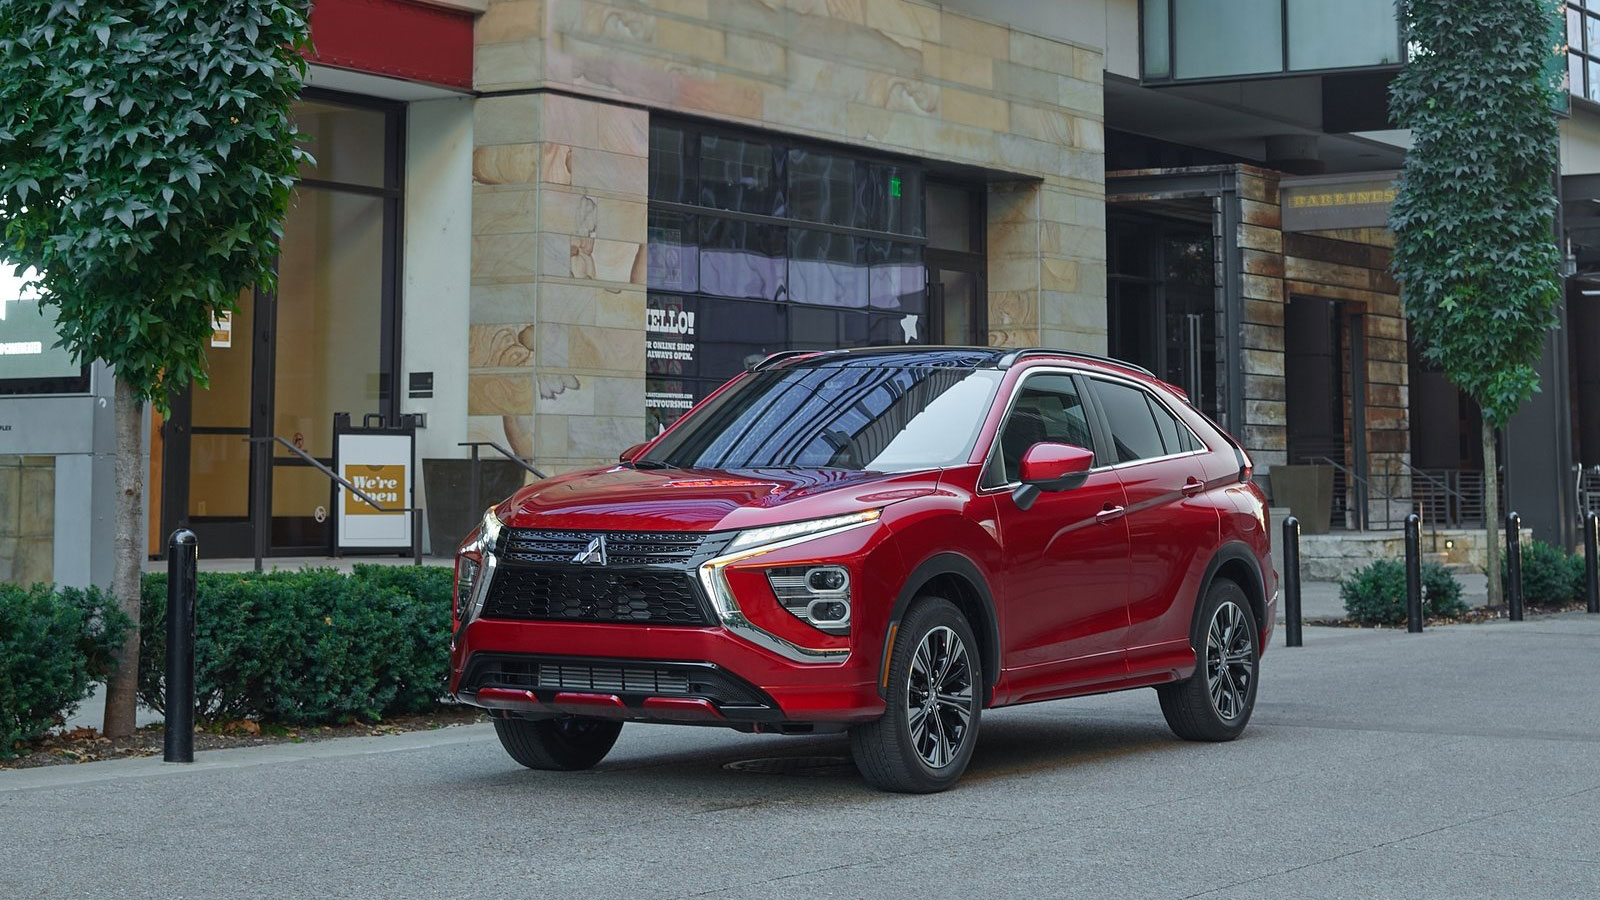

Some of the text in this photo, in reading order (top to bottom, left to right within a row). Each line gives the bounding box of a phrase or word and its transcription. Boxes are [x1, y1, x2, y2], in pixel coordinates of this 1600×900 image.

[652, 341, 676, 350] ONLINE
[677, 342, 695, 351] SHOP
[647, 350, 693, 360] ALWAYS OPEN.
[353, 475, 397, 489] We're
